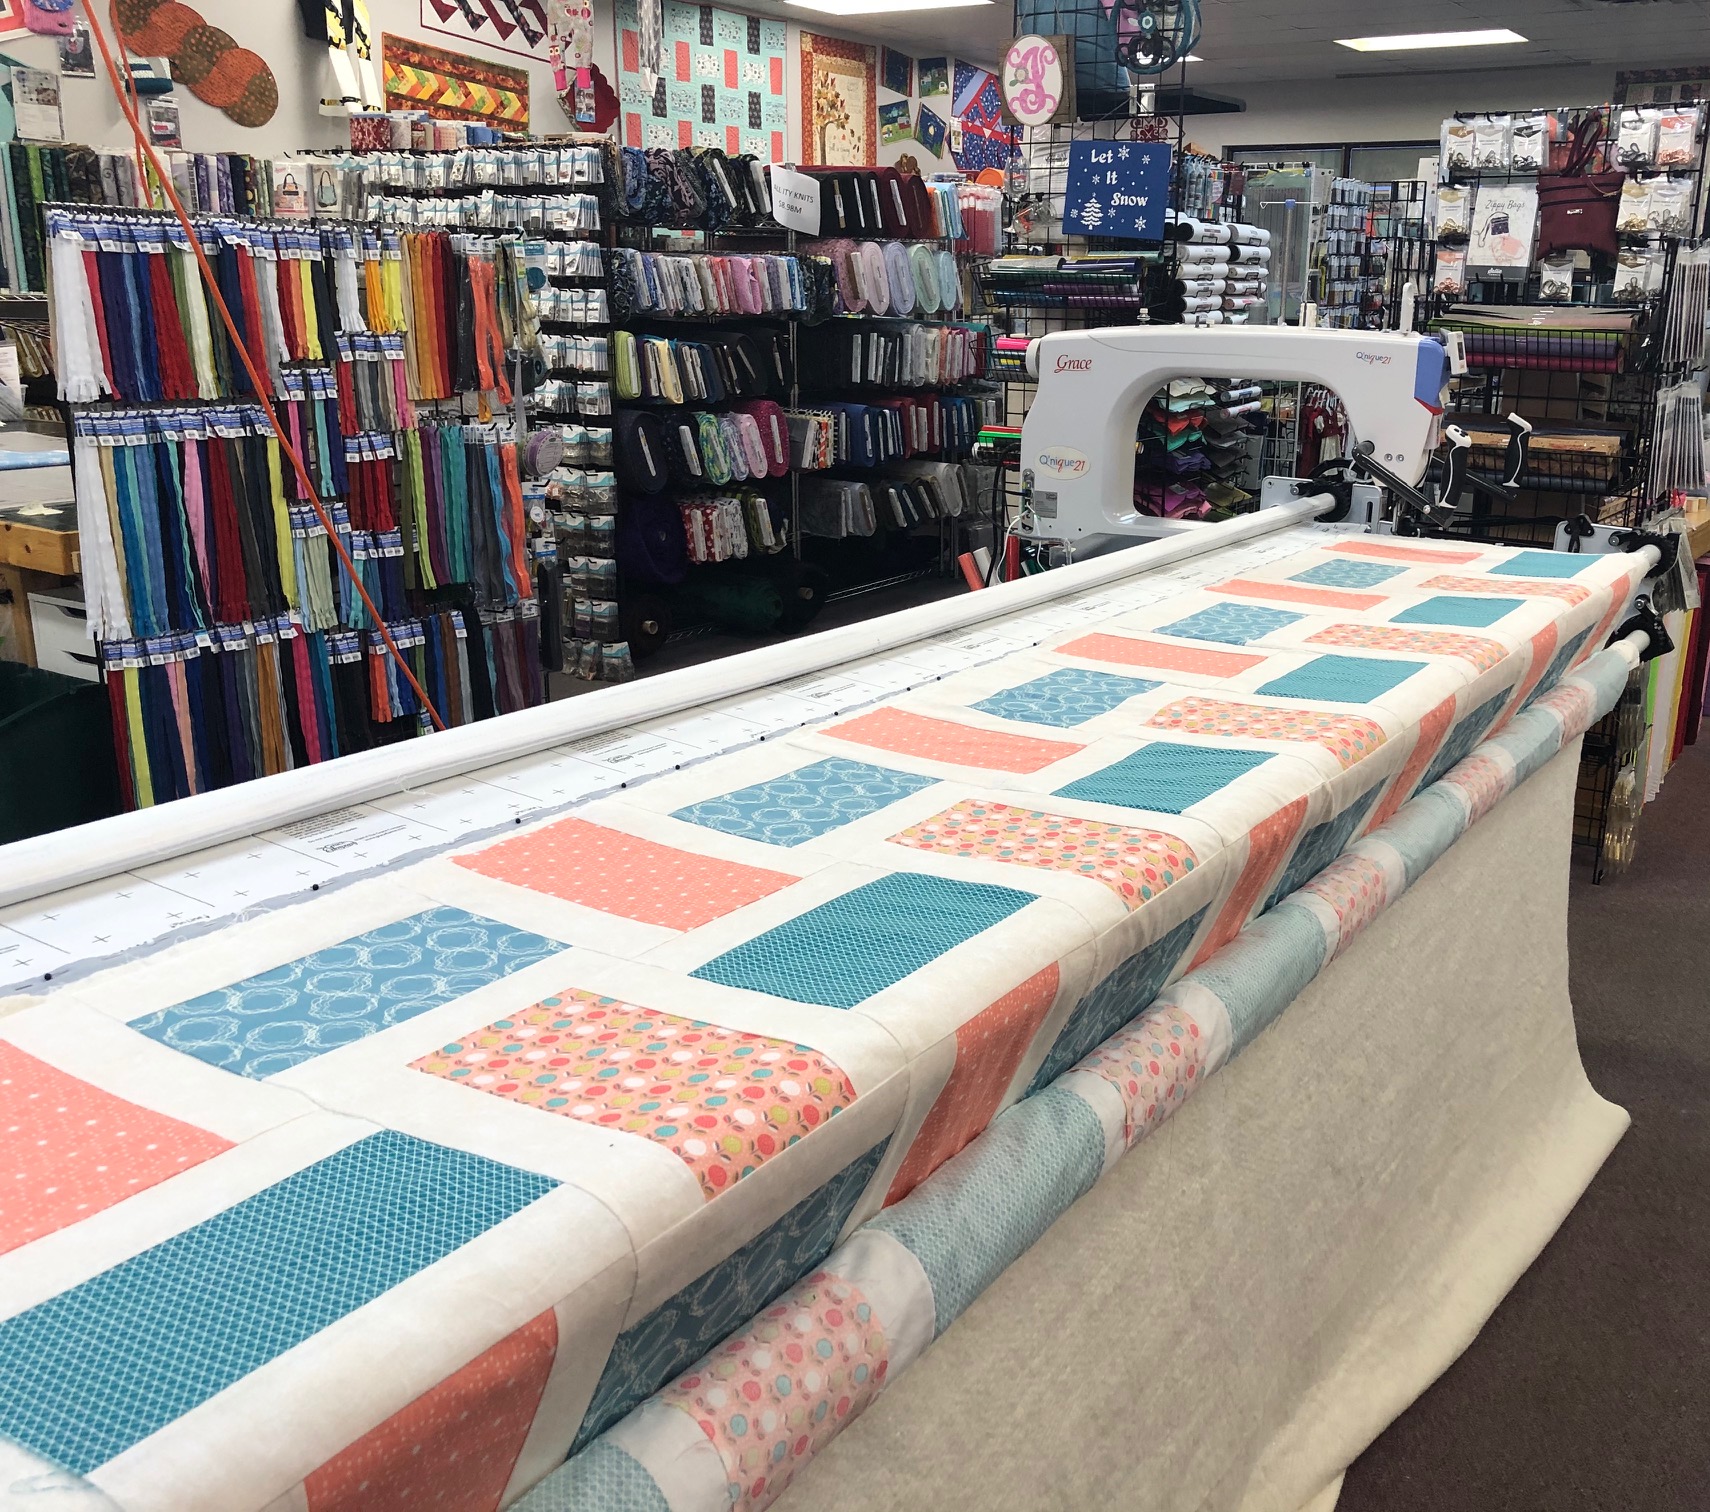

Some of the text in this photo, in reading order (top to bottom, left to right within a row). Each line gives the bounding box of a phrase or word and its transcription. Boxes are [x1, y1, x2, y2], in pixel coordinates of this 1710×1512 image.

[1090, 148, 1114, 164] Let
[1106, 170, 1118, 185] It
[793, 192, 814, 203] KNITS
[1110, 192, 1149, 206] Snow
[1484, 199, 1526, 213] Zippy Bags
[1053, 353, 1093, 374] Grace
